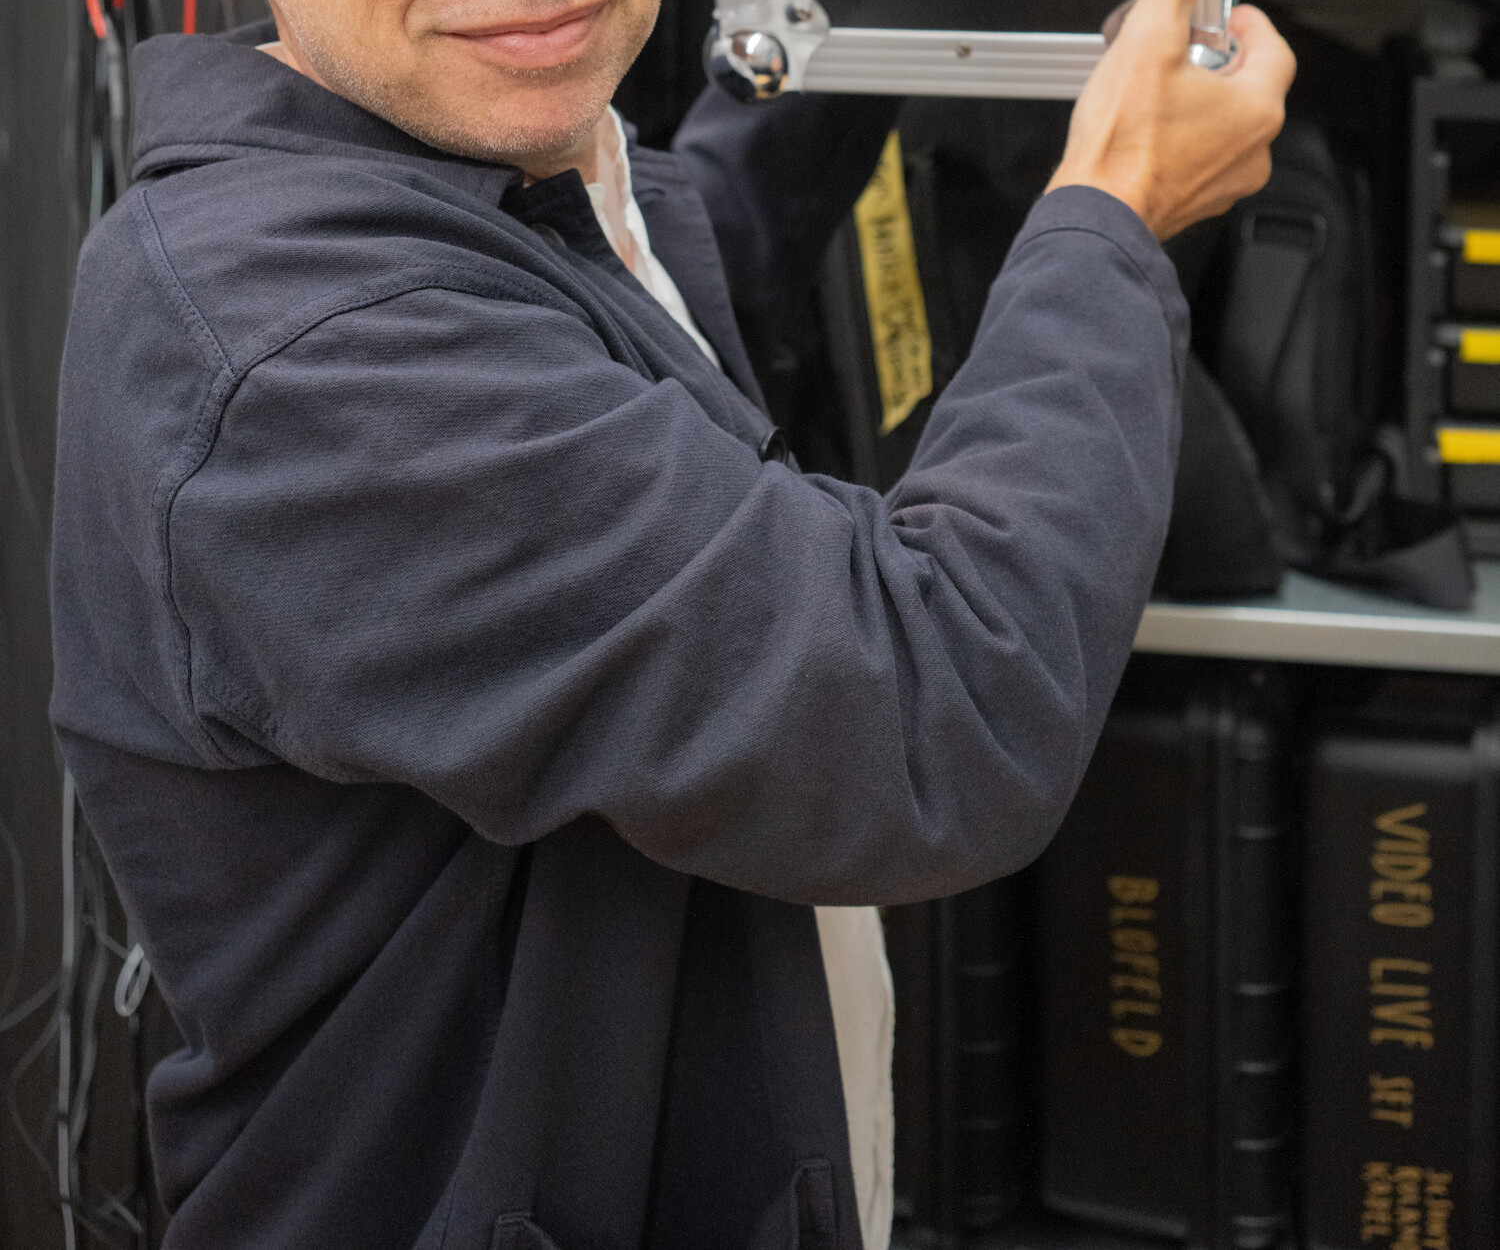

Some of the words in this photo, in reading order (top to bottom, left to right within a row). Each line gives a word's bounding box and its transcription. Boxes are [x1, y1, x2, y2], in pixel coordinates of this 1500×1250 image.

[1370, 803, 1434, 927] VIDEO
[1108, 875, 1163, 1058] BLOFELD
[1369, 958, 1434, 1049] LIVE
[1369, 1072, 1415, 1130] SET
